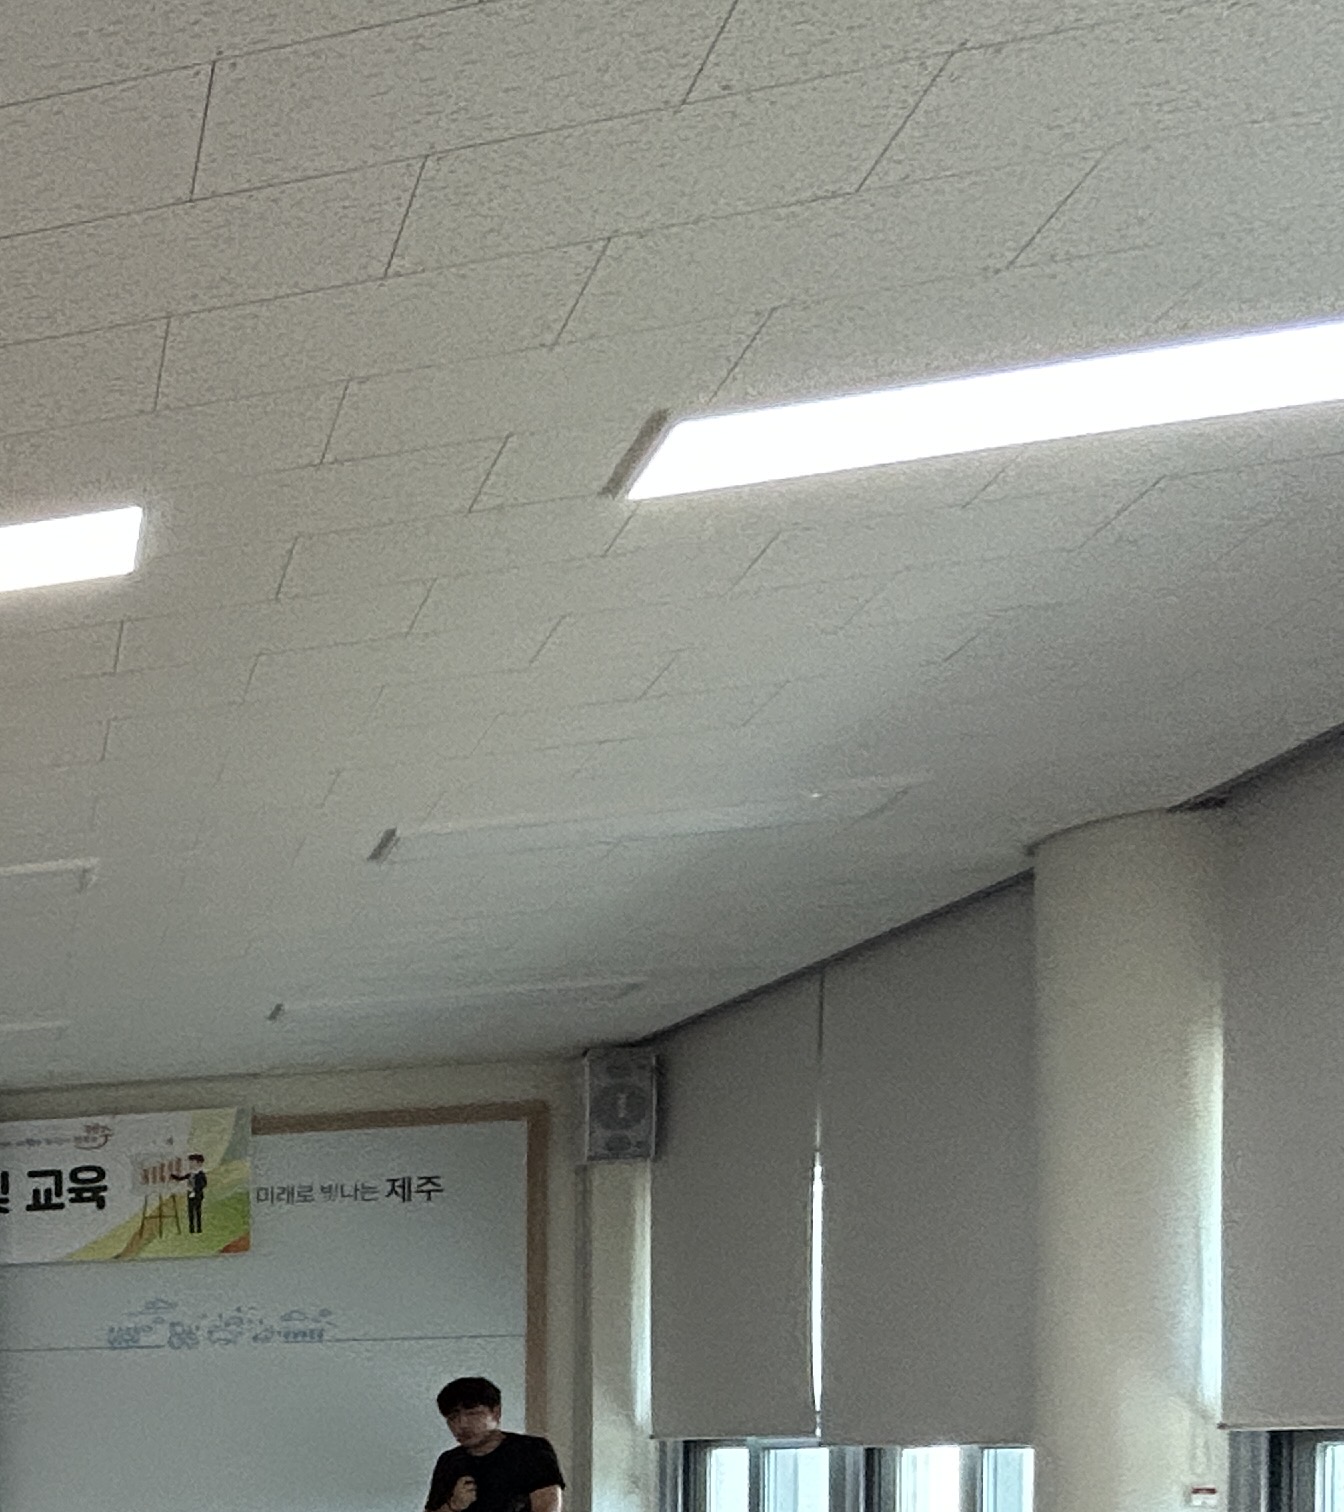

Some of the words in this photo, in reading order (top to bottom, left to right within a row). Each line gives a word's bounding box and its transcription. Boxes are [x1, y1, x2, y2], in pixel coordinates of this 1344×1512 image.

[25, 1165, 108, 1211] 교육
[256, 1183, 315, 1205] 미래로
[384, 1175, 444, 1204] 제주
